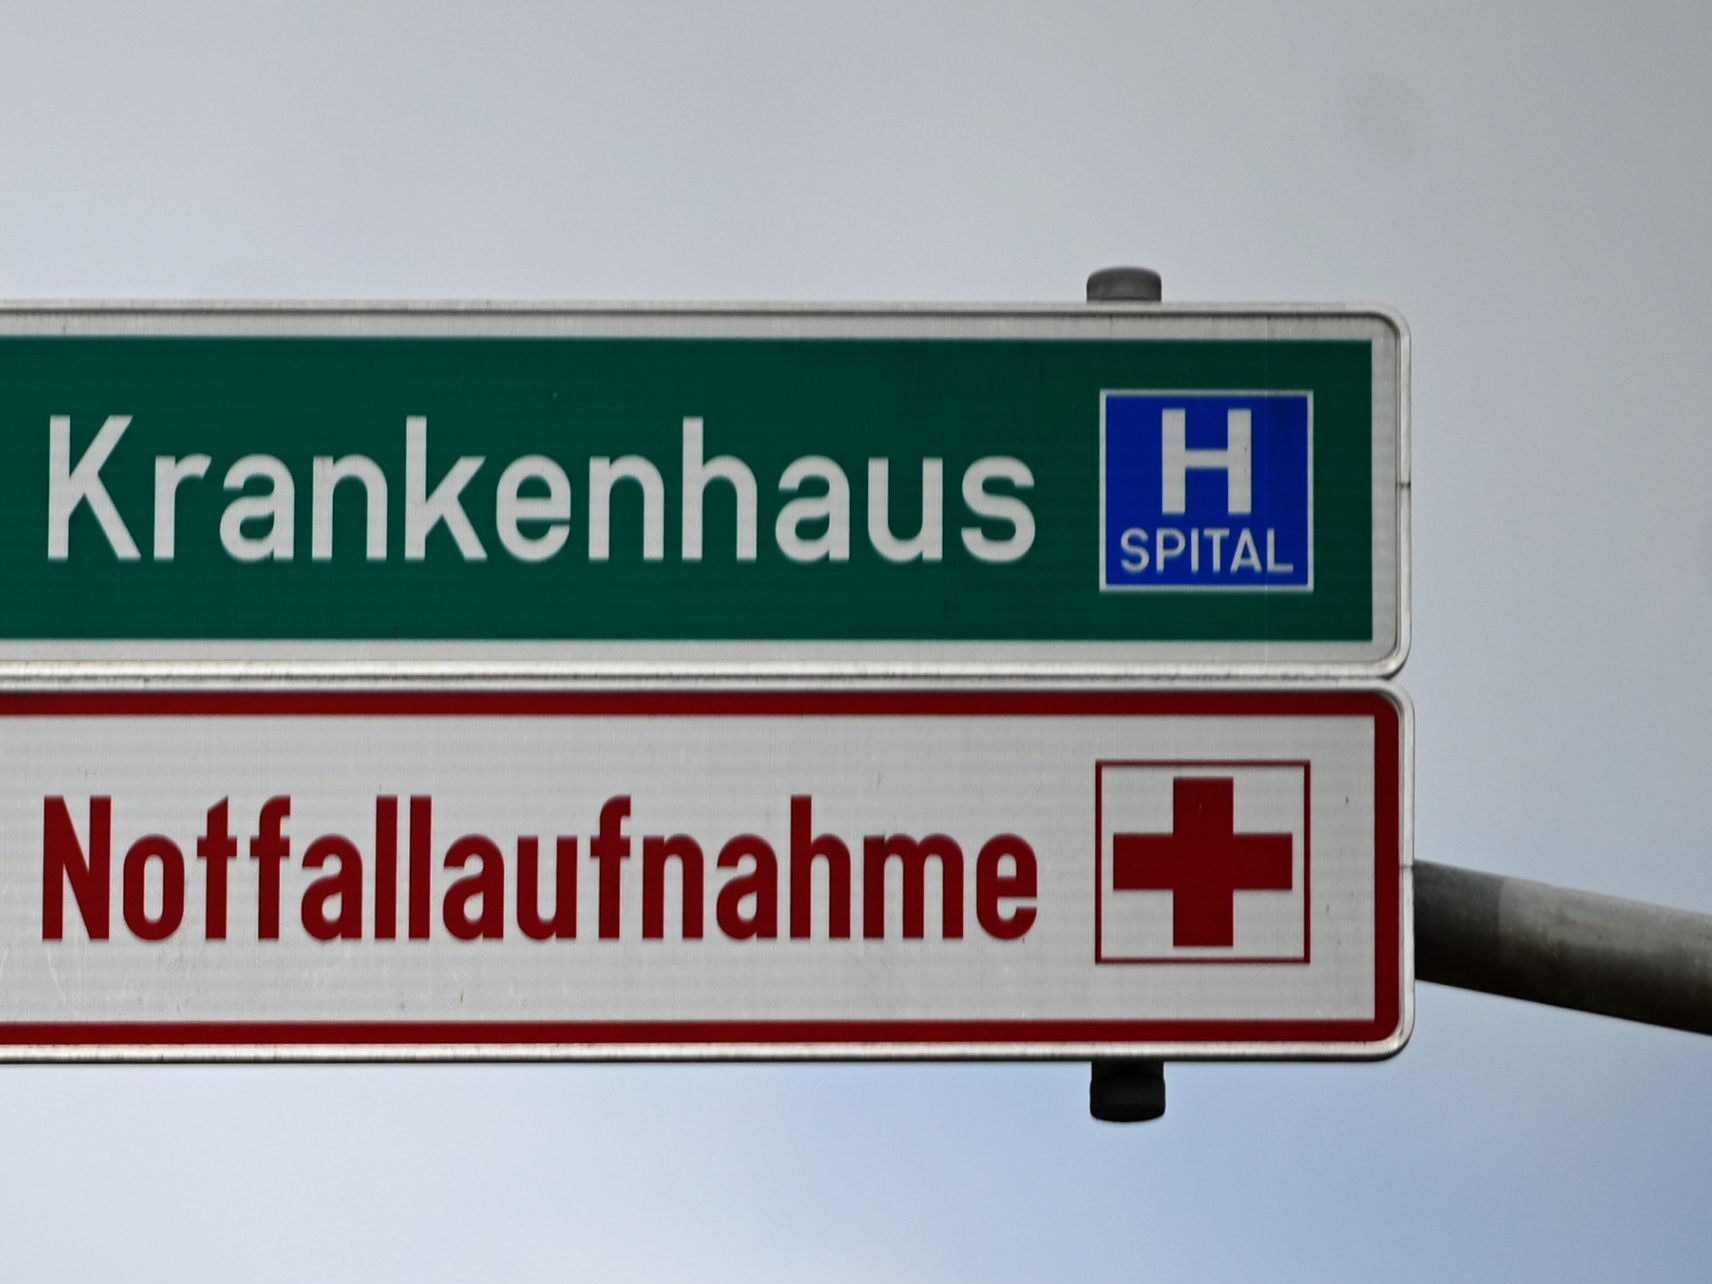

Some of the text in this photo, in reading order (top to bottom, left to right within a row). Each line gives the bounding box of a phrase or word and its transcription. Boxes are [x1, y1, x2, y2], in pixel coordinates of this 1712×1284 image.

[46, 414, 1037, 563] Krankenhaus
[1161, 408, 1252, 515] H
[1120, 527, 1294, 573] SPITAL
[41, 794, 1039, 943] Notfallaufnahme
